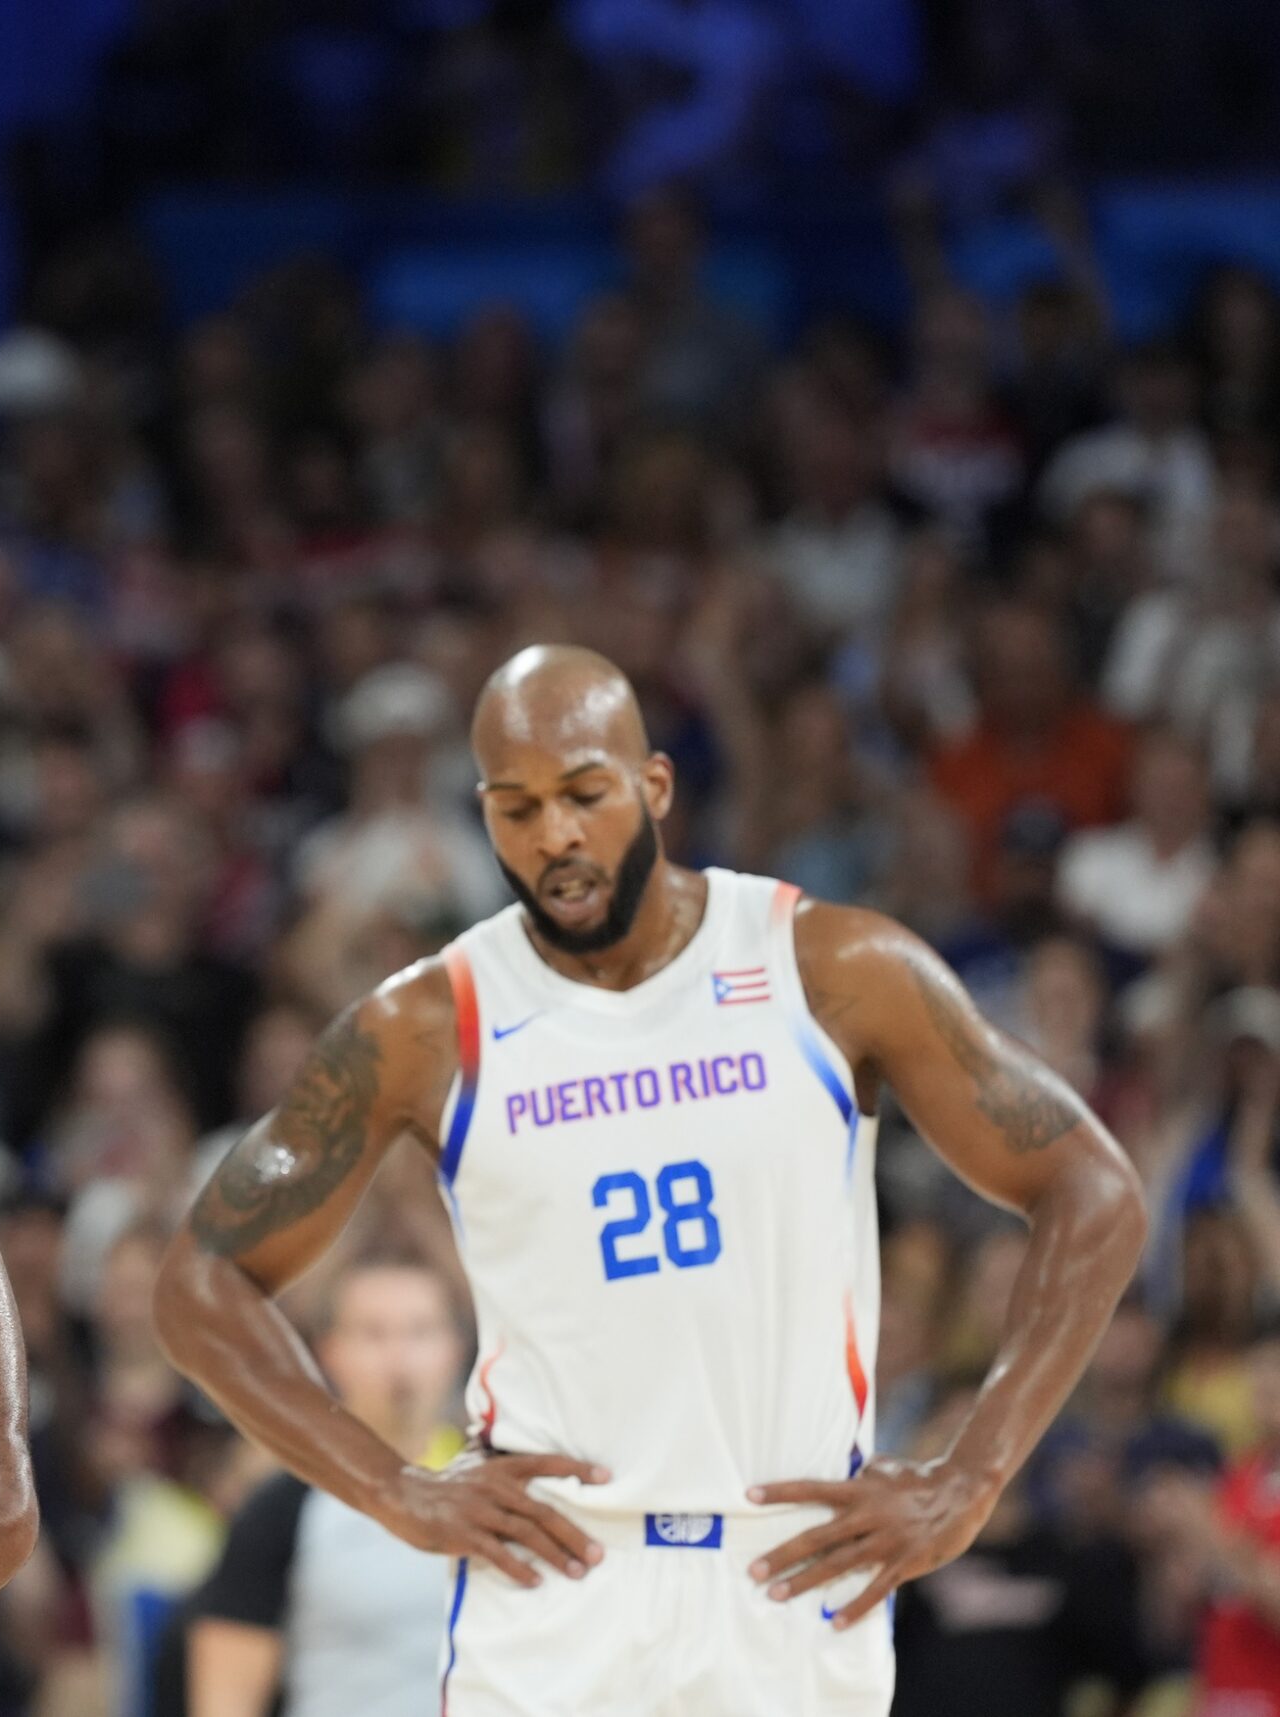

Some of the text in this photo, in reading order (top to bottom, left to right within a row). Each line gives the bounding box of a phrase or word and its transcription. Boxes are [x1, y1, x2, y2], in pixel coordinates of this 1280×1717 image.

[506, 1052, 767, 1135] PUERTO RICO
[591, 1159, 722, 1281] 28
